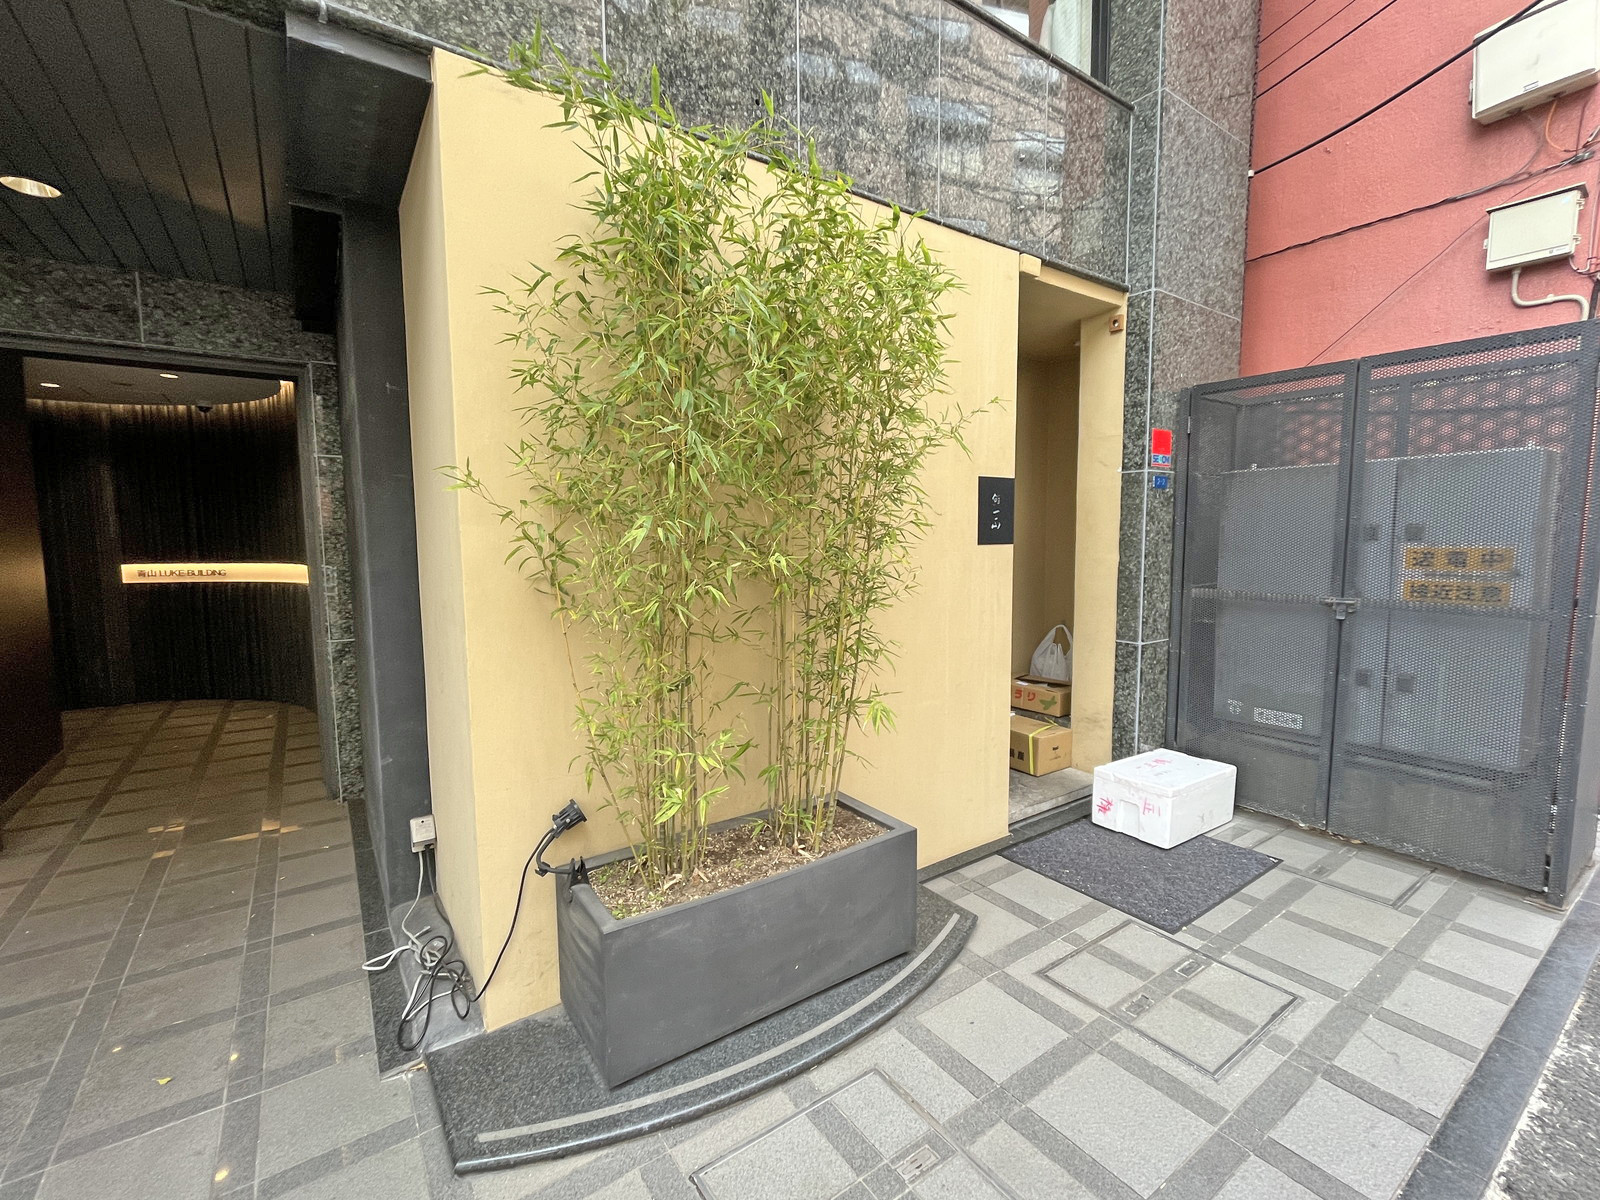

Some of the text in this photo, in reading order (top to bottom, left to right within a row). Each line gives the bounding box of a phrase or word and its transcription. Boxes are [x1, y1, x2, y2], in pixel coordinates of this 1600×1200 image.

[1411, 549, 1504, 569] 送電中
[137, 569, 227, 578] 青山 LUKE BUILDING
[1409, 583, 1503, 602] 接近注意
